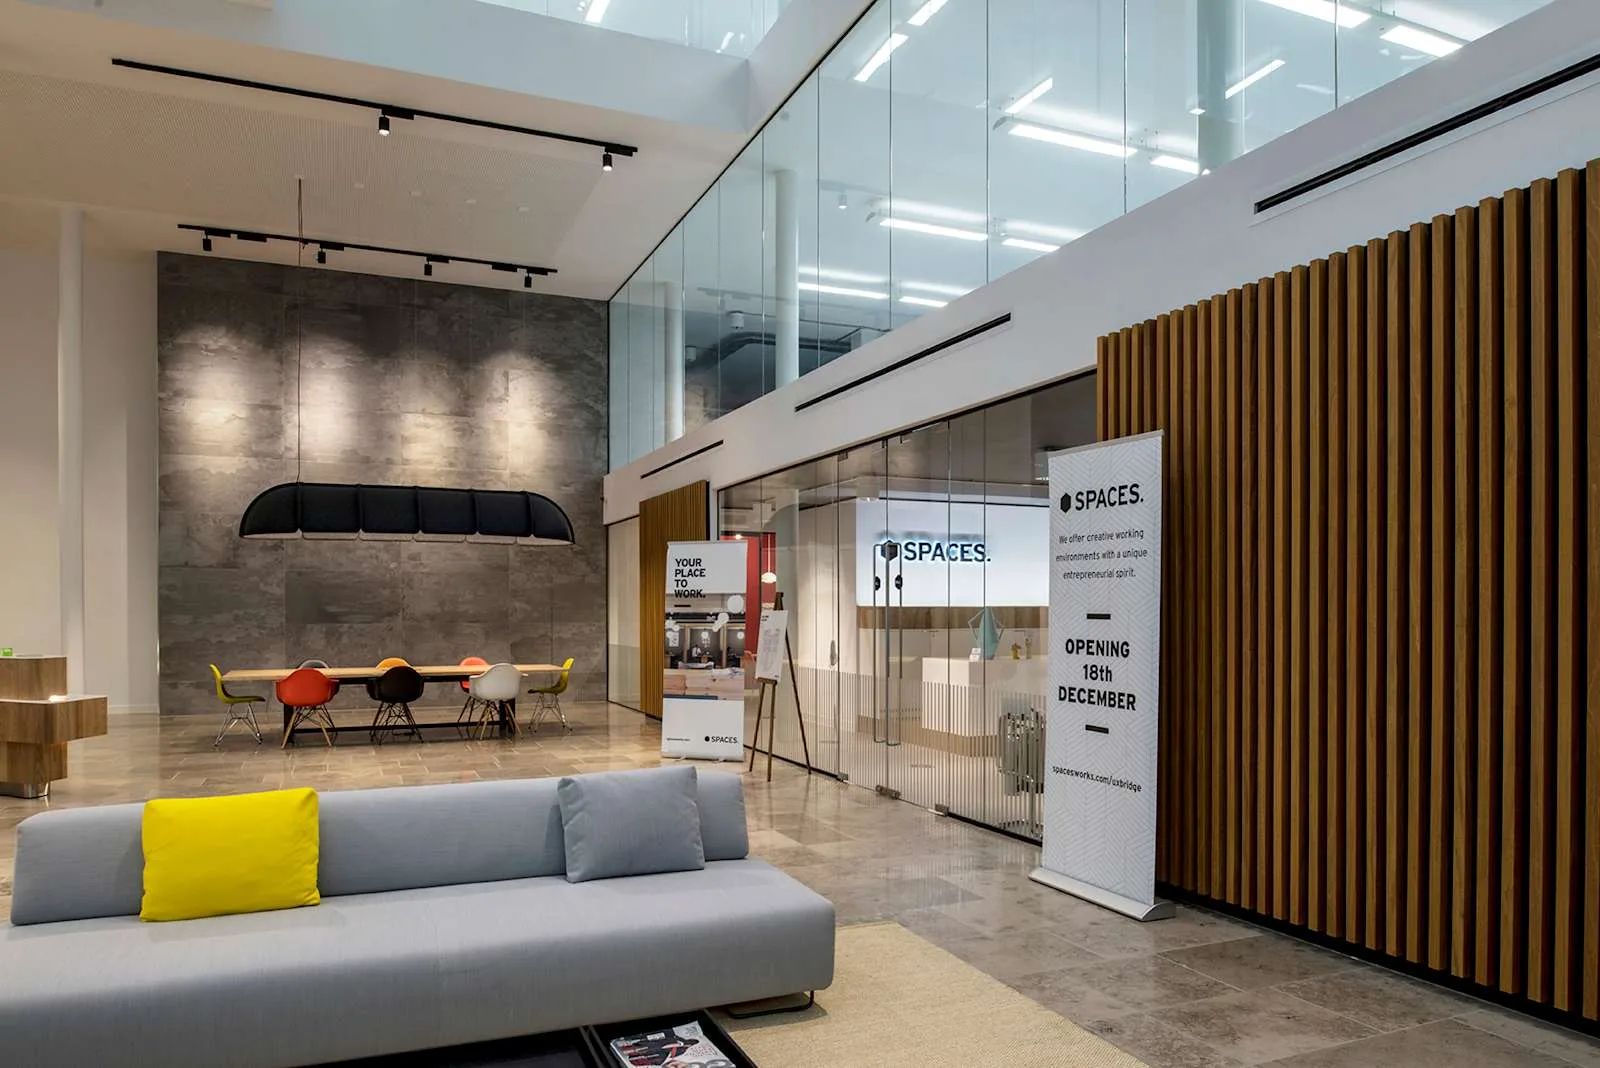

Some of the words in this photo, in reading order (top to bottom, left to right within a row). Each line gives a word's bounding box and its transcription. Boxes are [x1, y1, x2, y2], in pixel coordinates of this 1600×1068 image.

[1075, 483, 1144, 511] SPACES.
[1059, 535, 1068, 544] We
[1068, 534, 1085, 544] offer
[1086, 531, 1114, 543] creative
[1115, 529, 1144, 541] working
[904, 541, 991, 562] SPACES.
[1056, 551, 1100, 562] environments
[1101, 550, 1115, 560] with
[1122, 548, 1148, 561] unique
[675, 558, 702, 568] YOUR
[674, 568, 706, 578] PLACE
[1063, 568, 1114, 581] entrepreneurial
[1115, 568, 1136, 580] spirit.
[674, 578, 688, 588] TO
[674, 589, 706, 598] WORK.
[1065, 638, 1130, 658] OPENING
[1083, 664, 1112, 682] 18th
[1058, 686, 1136, 711] DECEMBER
[1052, 765, 1142, 793] spacesworks.com/uxbridge
